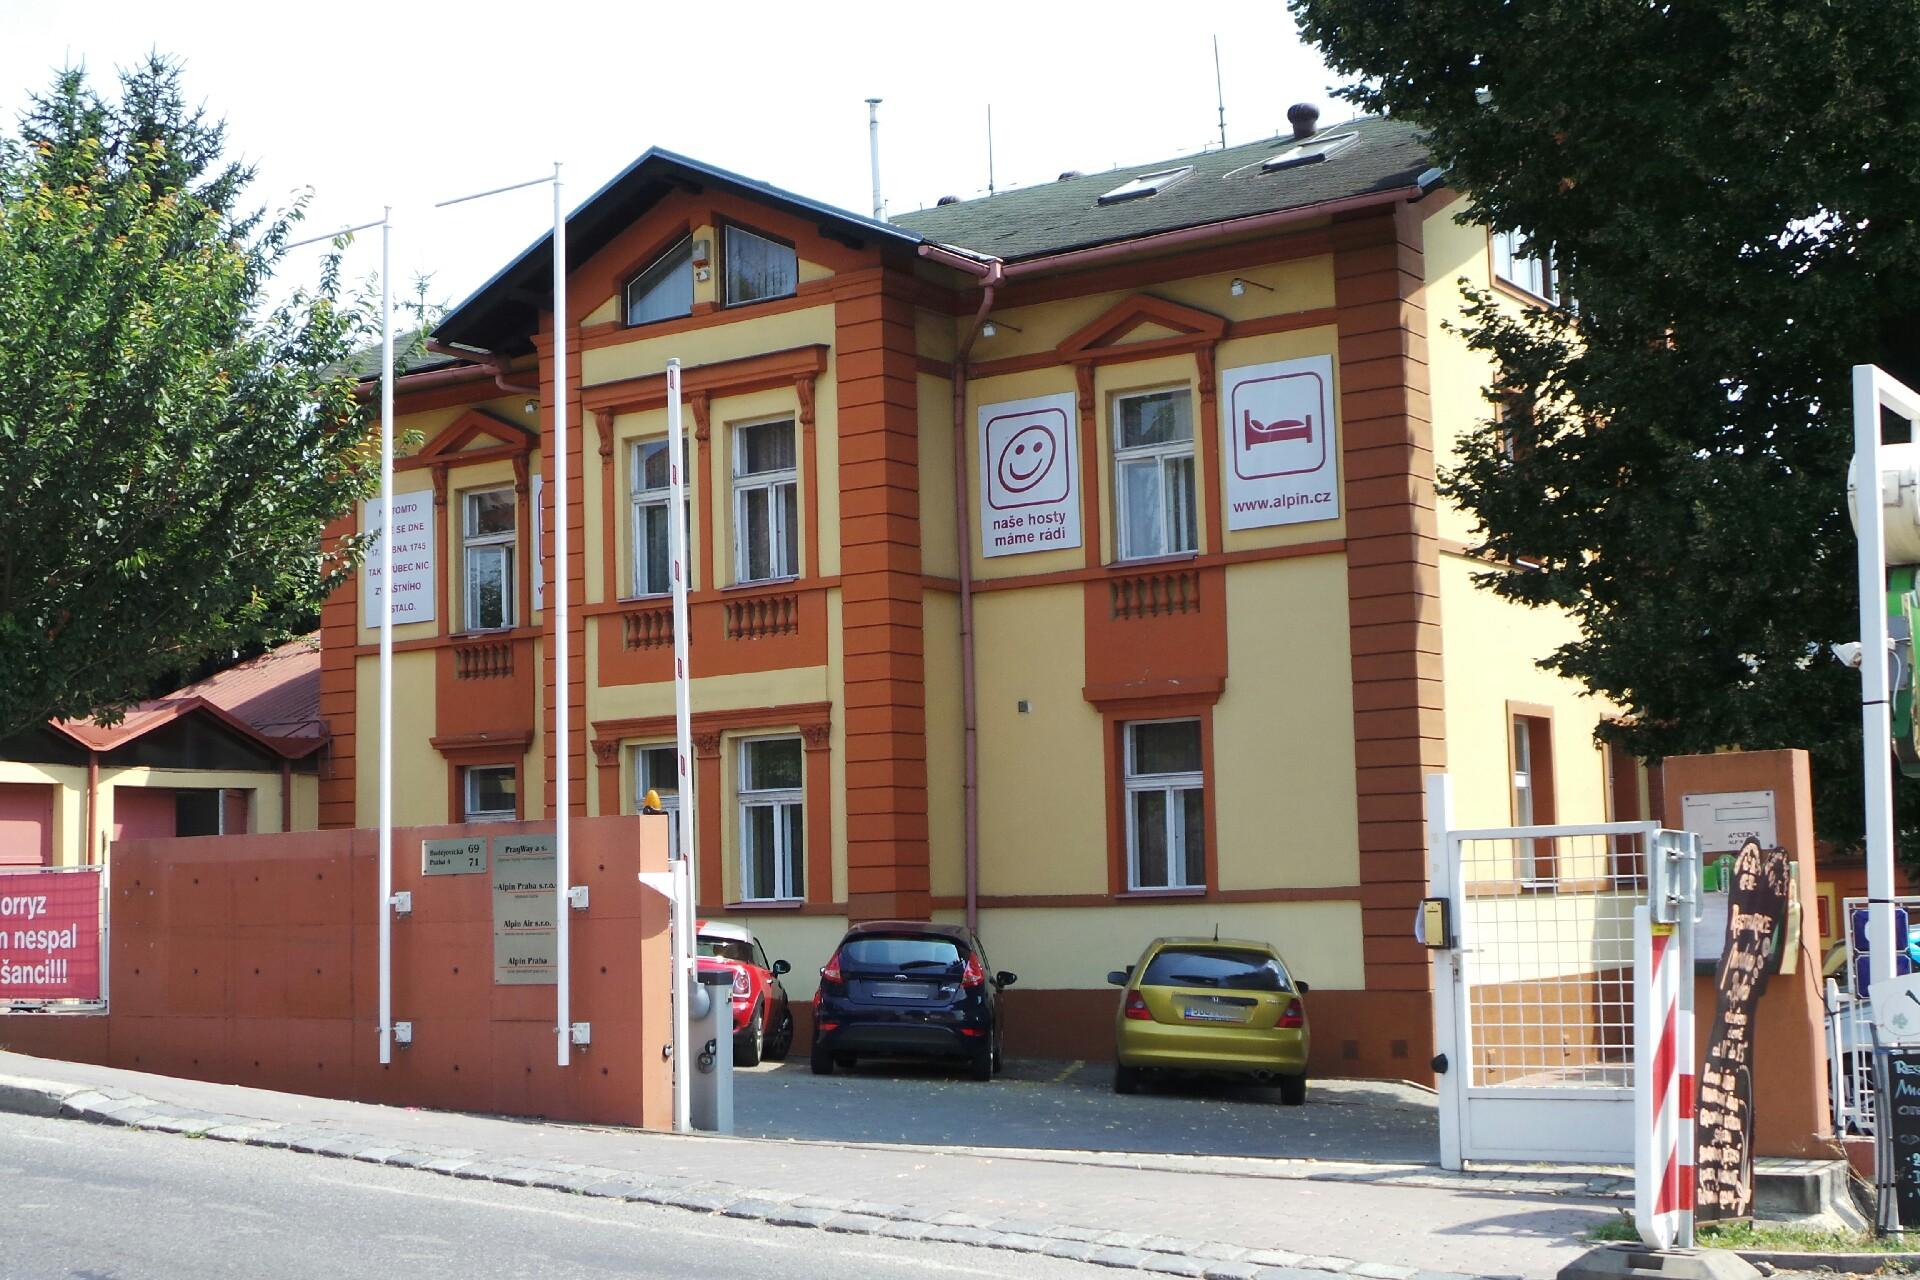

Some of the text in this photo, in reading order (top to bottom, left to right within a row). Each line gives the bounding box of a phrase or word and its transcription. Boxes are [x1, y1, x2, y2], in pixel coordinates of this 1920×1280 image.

[1233, 491, 1332, 513] www.alpin.cz
[993, 511, 1066, 530] naše hosty
[396, 525, 406, 534] SE
[408, 522, 424, 532] DNE
[994, 527, 1066, 547] máme rádi
[415, 561, 429, 571] NIC
[467, 844, 480, 854] 69
[469, 858, 479, 867] 71
[517, 882, 536, 890] Praha
[523, 919, 532, 927] Air
[14, 923, 77, 954] nespal
[1, 959, 68, 984] šanci!!!
